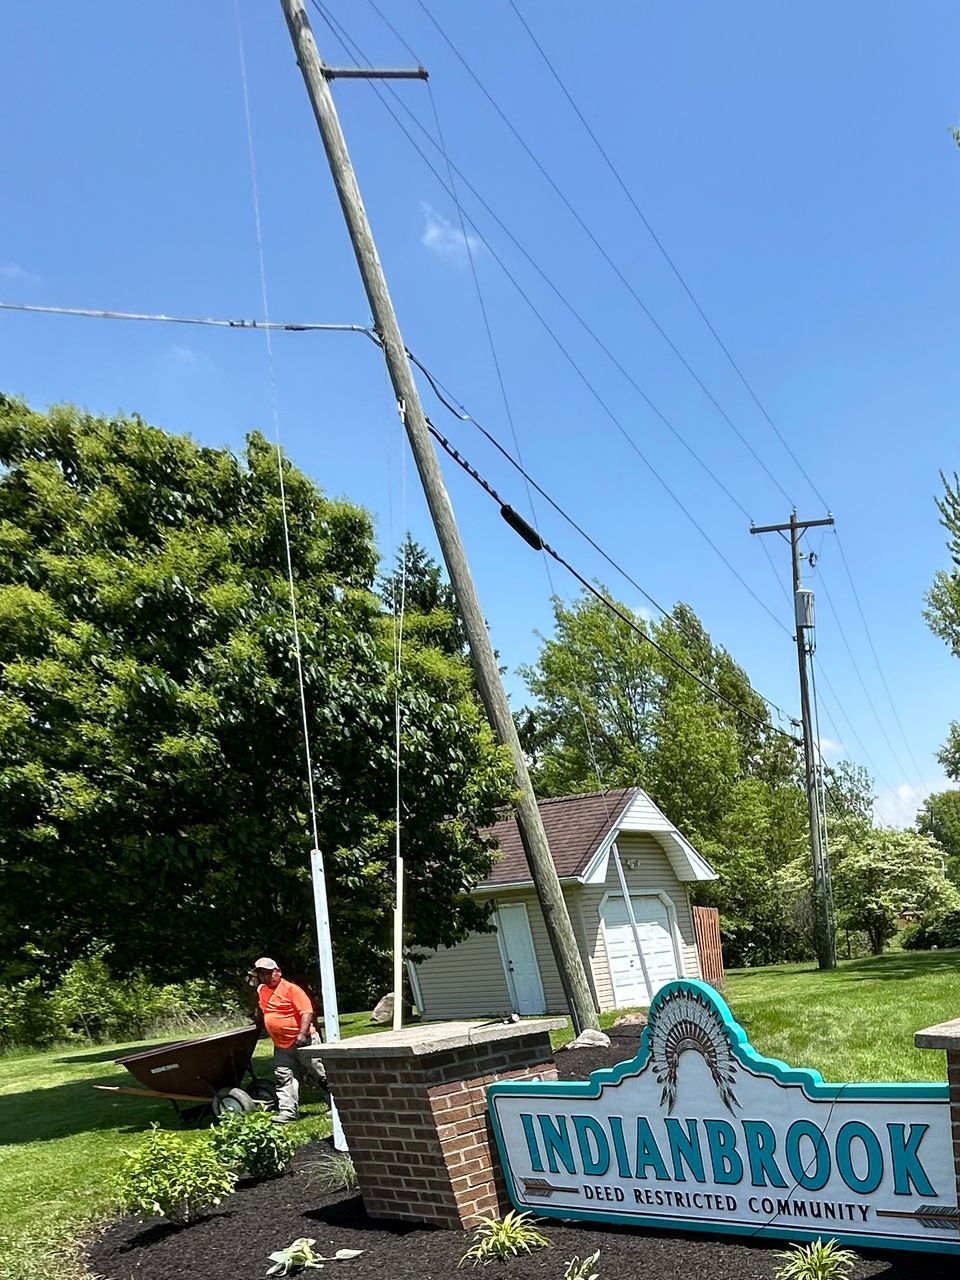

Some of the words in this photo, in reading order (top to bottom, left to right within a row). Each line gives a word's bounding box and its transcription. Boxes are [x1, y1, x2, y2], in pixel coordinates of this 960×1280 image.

[519, 1113, 938, 1197] INDIANBROOK
[584, 1184, 625, 1203] DEED
[634, 1188, 738, 1212] RESTRICTED
[748, 1197, 870, 1222] COMMUNITY
